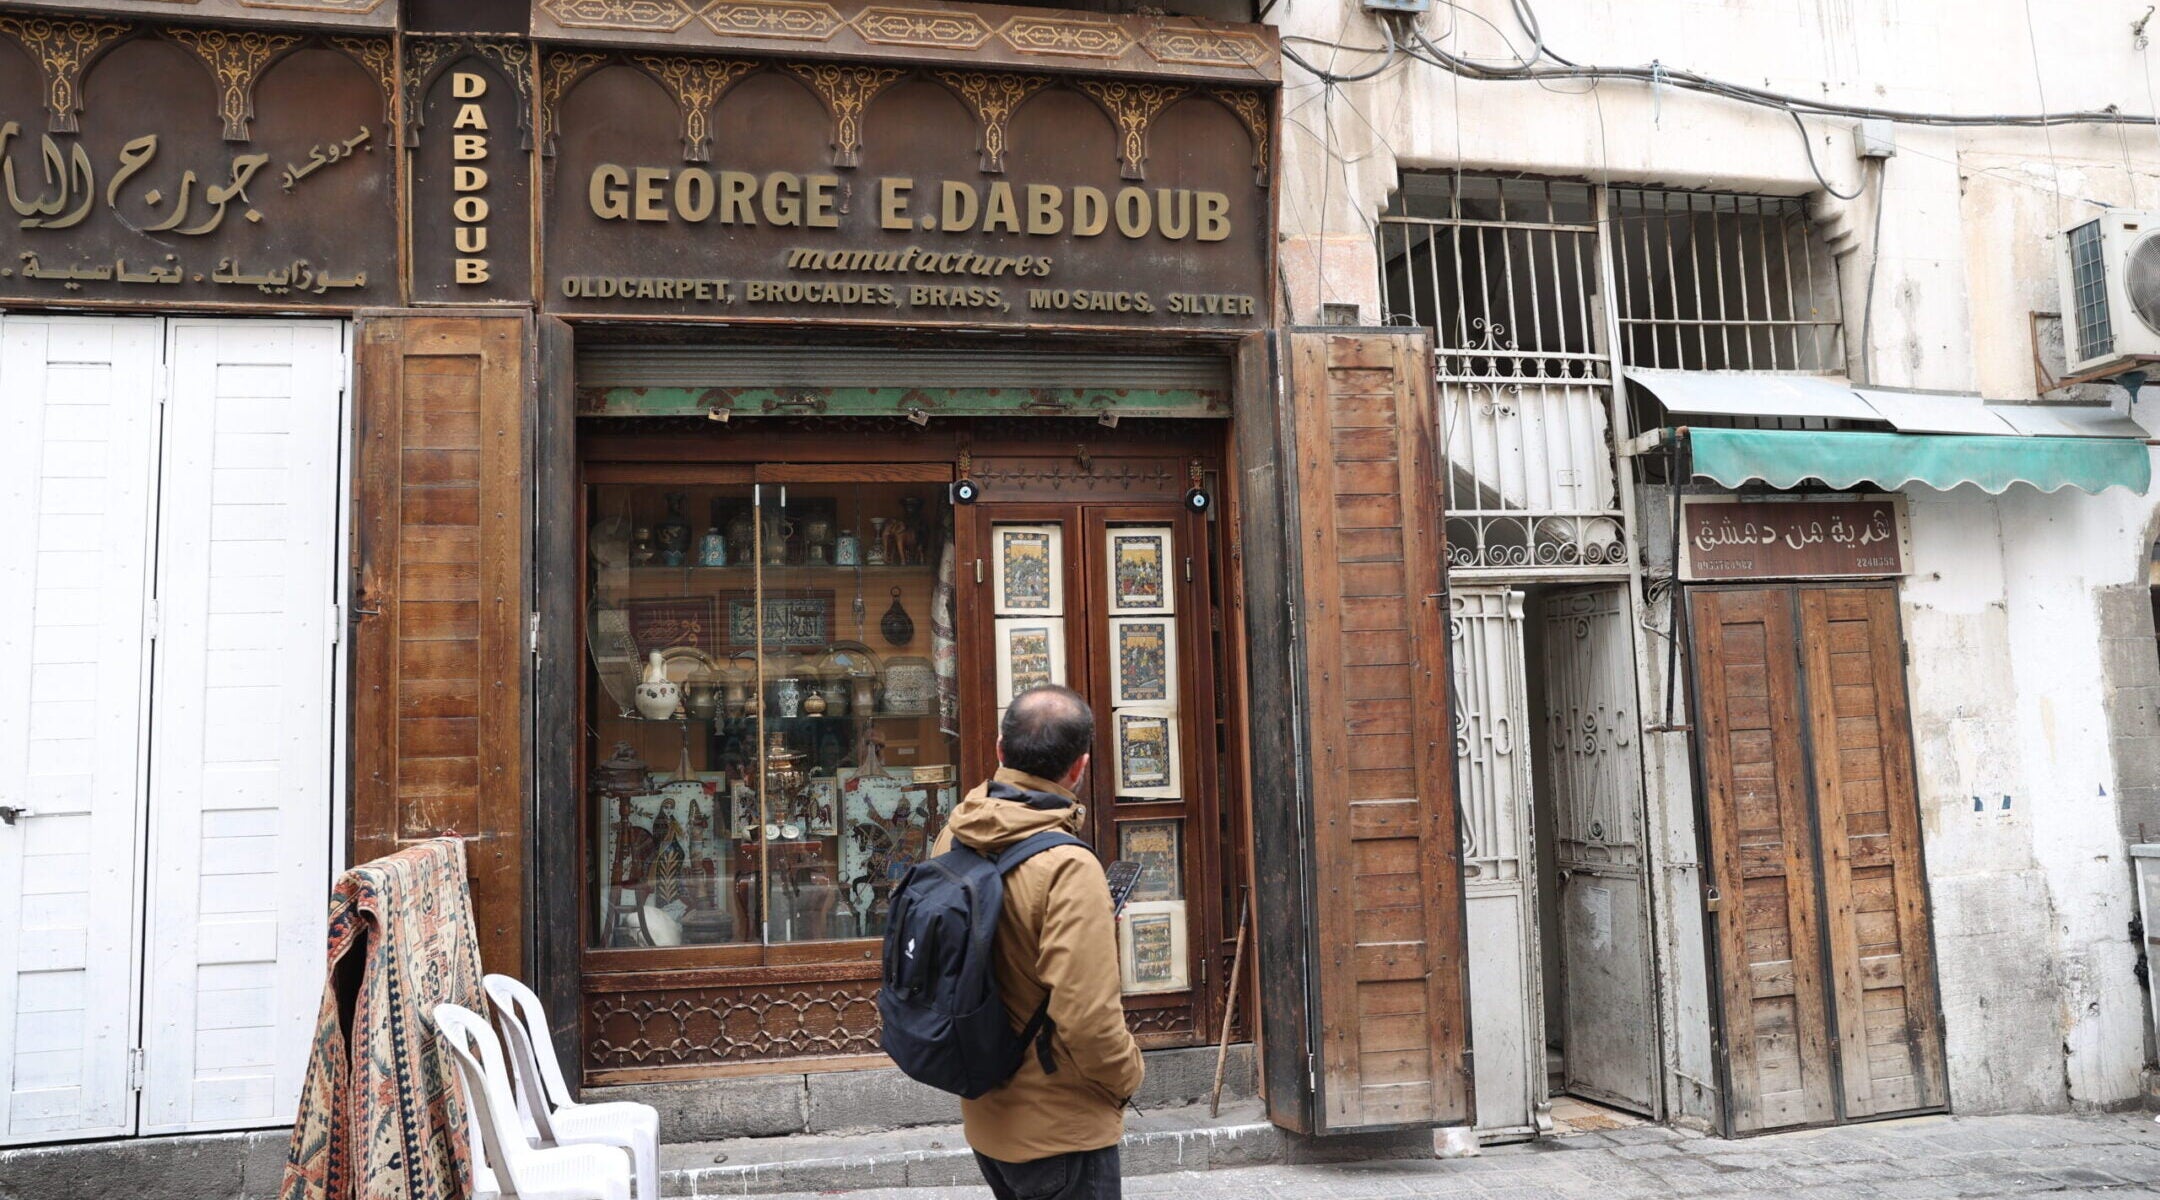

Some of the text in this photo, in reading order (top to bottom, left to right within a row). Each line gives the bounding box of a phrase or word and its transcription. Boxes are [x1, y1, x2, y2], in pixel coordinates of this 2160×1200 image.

[107, 134, 269, 236] جورج
[452, 72, 490, 285] DABDOUB
[589, 163, 840, 229] GEORGE
[19, 250, 184, 290] نحاسية
[787, 245, 1053, 277] manufactures
[561, 276, 737, 305] OLDCARPET,
[745, 280, 903, 309] BROCADES,
[910, 284, 1012, 314] BRASS,
[1167, 293, 1256, 317] SILVER
[1694, 515, 1778, 552] دمشق
[1785, 521, 1824, 551] من
